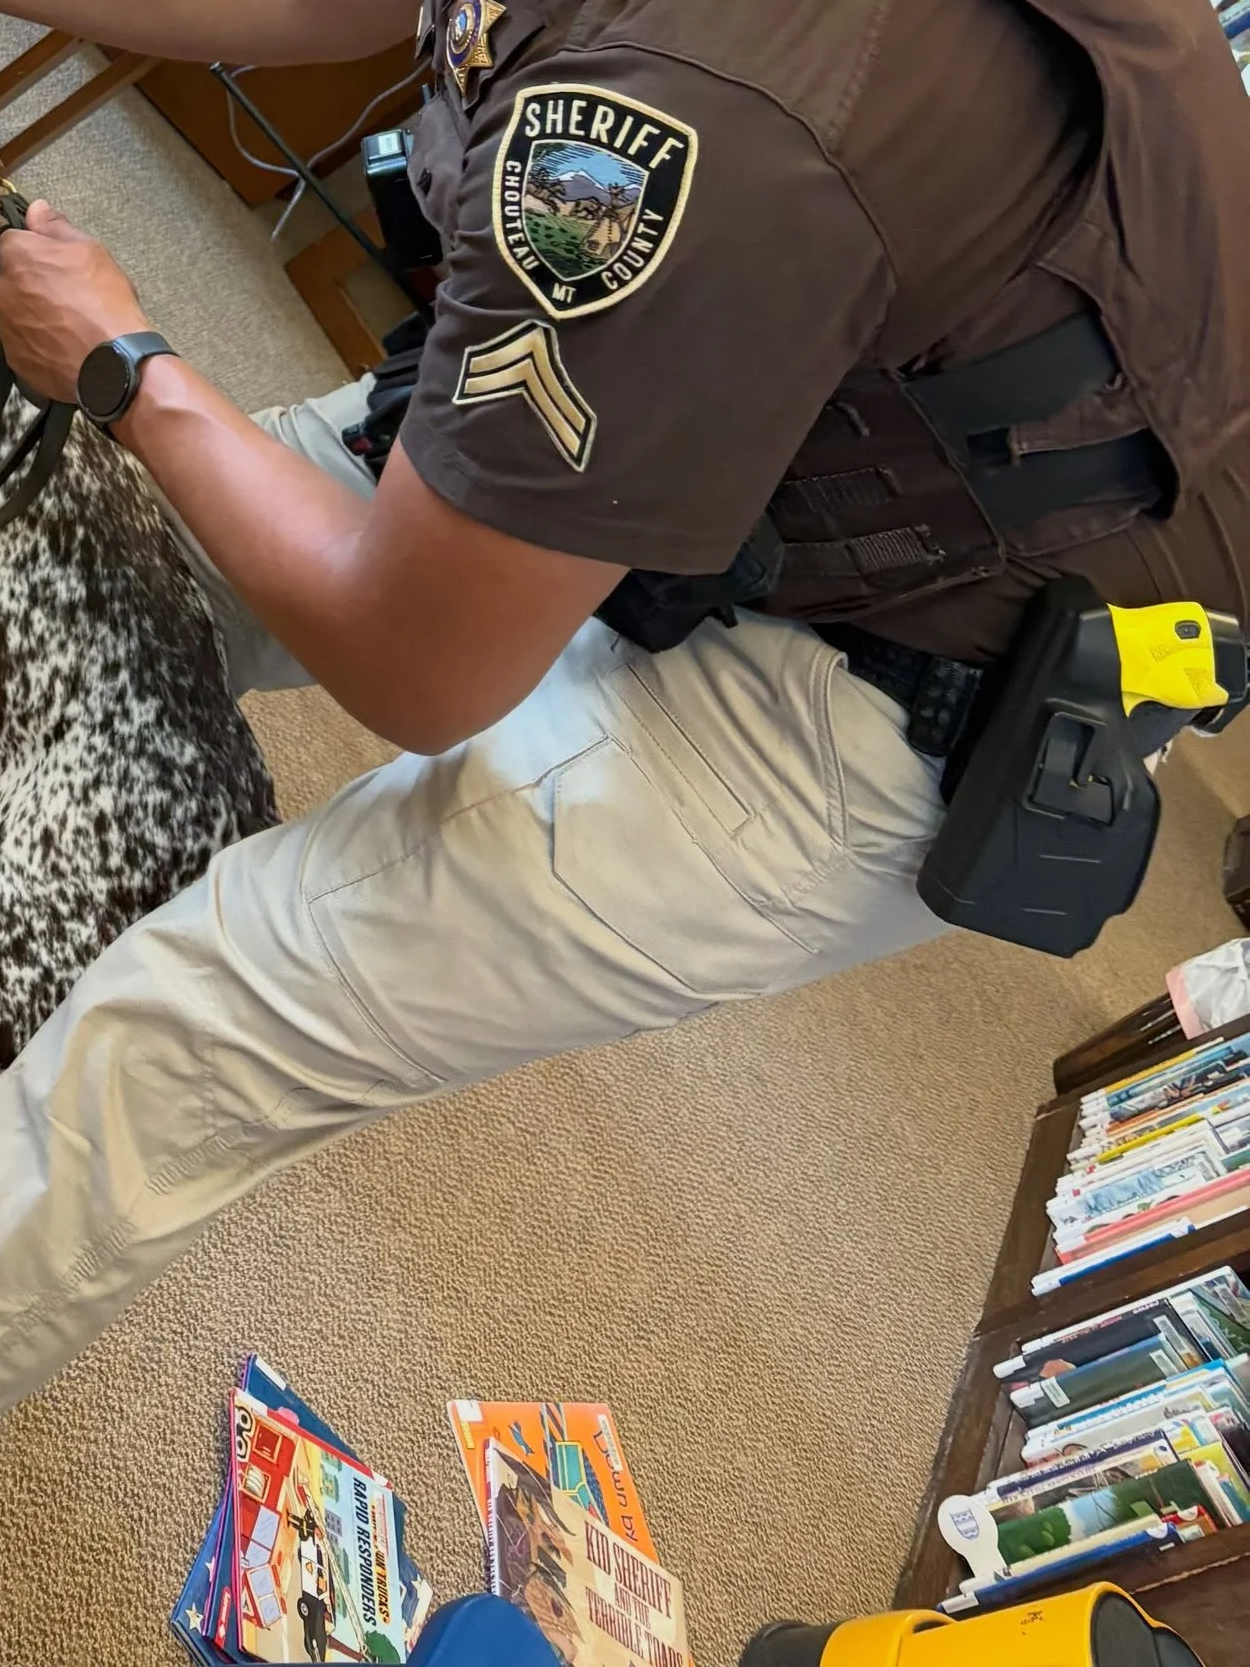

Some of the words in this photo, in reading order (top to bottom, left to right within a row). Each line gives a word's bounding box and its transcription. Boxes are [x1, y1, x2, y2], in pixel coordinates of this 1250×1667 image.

[524, 99, 685, 169] SHERIFF
[504, 160, 540, 271] CHOUTEAU
[601, 208, 664, 290] COUNTY
[552, 284, 576, 303] MT
[353, 1477, 370, 1527] RAPID
[620, 1515, 639, 1543] by
[356, 1526, 378, 1627] RESPONDERS
[379, 1567, 390, 1622] TRUCKS
[585, 1520, 612, 1576] KID
[613, 1542, 672, 1620] SHERIFF
[585, 1585, 645, 1660] TERRIBLE
[614, 1581, 632, 1616] AND
[632, 1594, 651, 1630] THE
